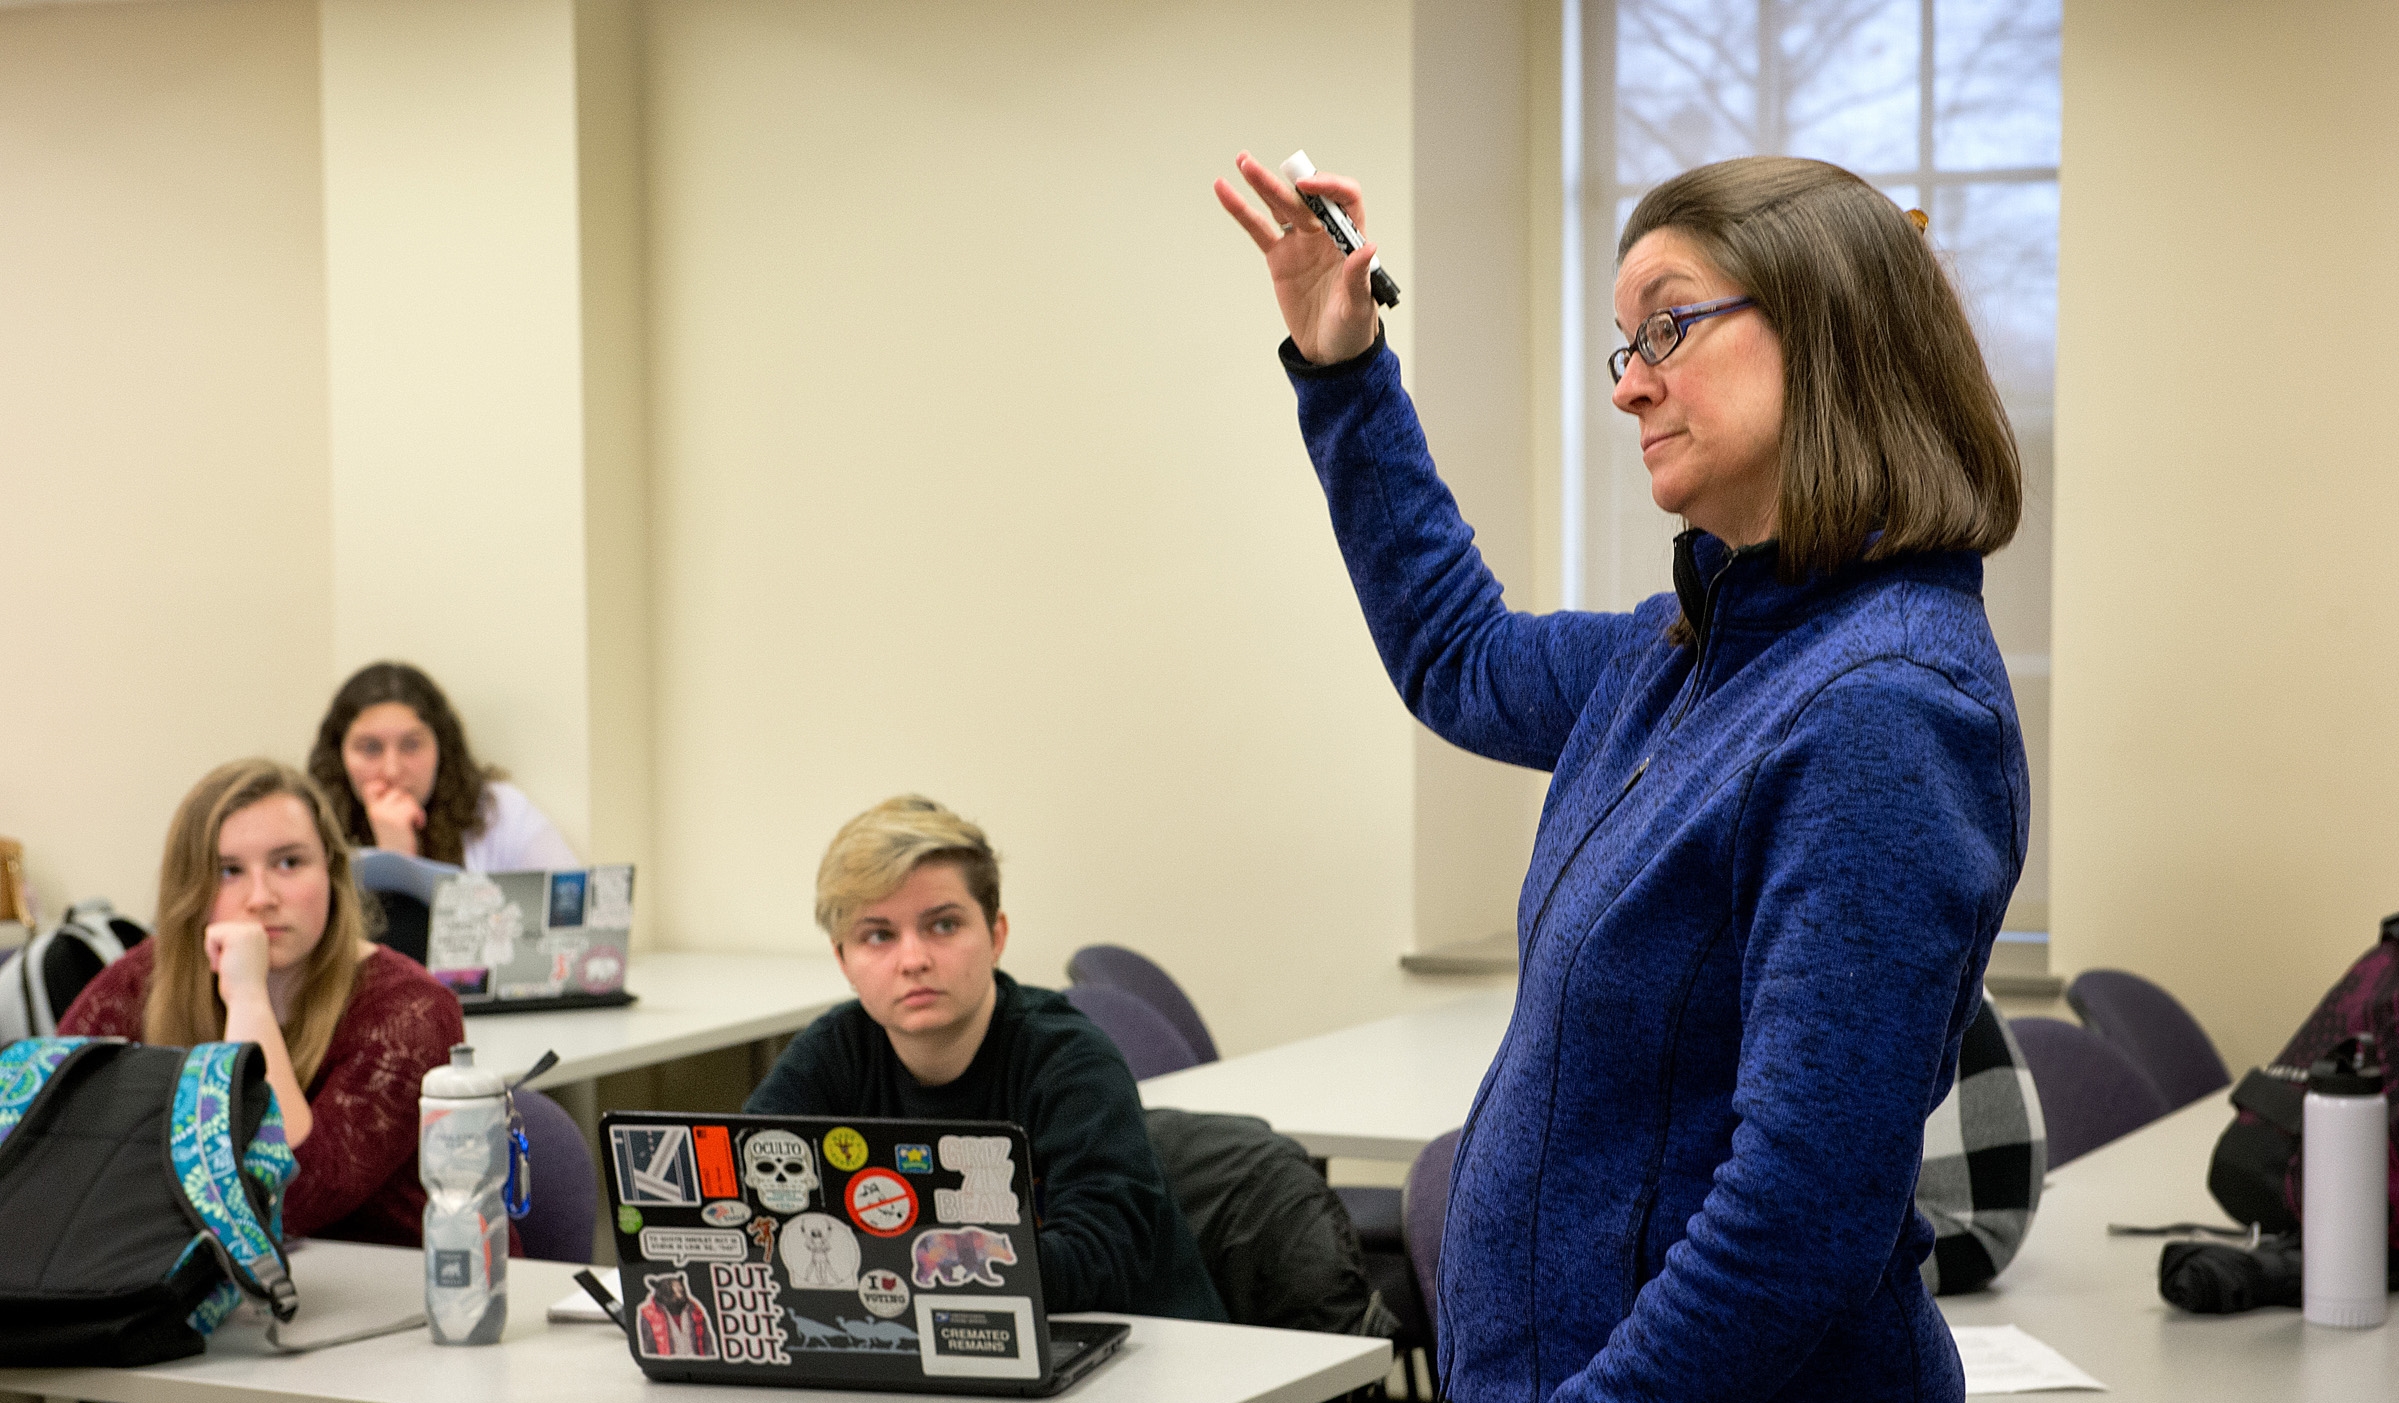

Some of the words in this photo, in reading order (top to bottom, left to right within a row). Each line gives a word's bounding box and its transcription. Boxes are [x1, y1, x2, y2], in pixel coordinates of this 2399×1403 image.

[753, 1142, 801, 1155] OCULTO
[935, 1190, 1018, 1223] BEAR
[714, 1266, 776, 1289] DUT.
[868, 1275, 879, 1290] I
[718, 1290, 780, 1313] DUT.
[721, 1313, 783, 1337] DUT.
[940, 1327, 1011, 1341] CREMATED
[725, 1337, 787, 1361] DUT.
[947, 1340, 1007, 1353] REMAINS
